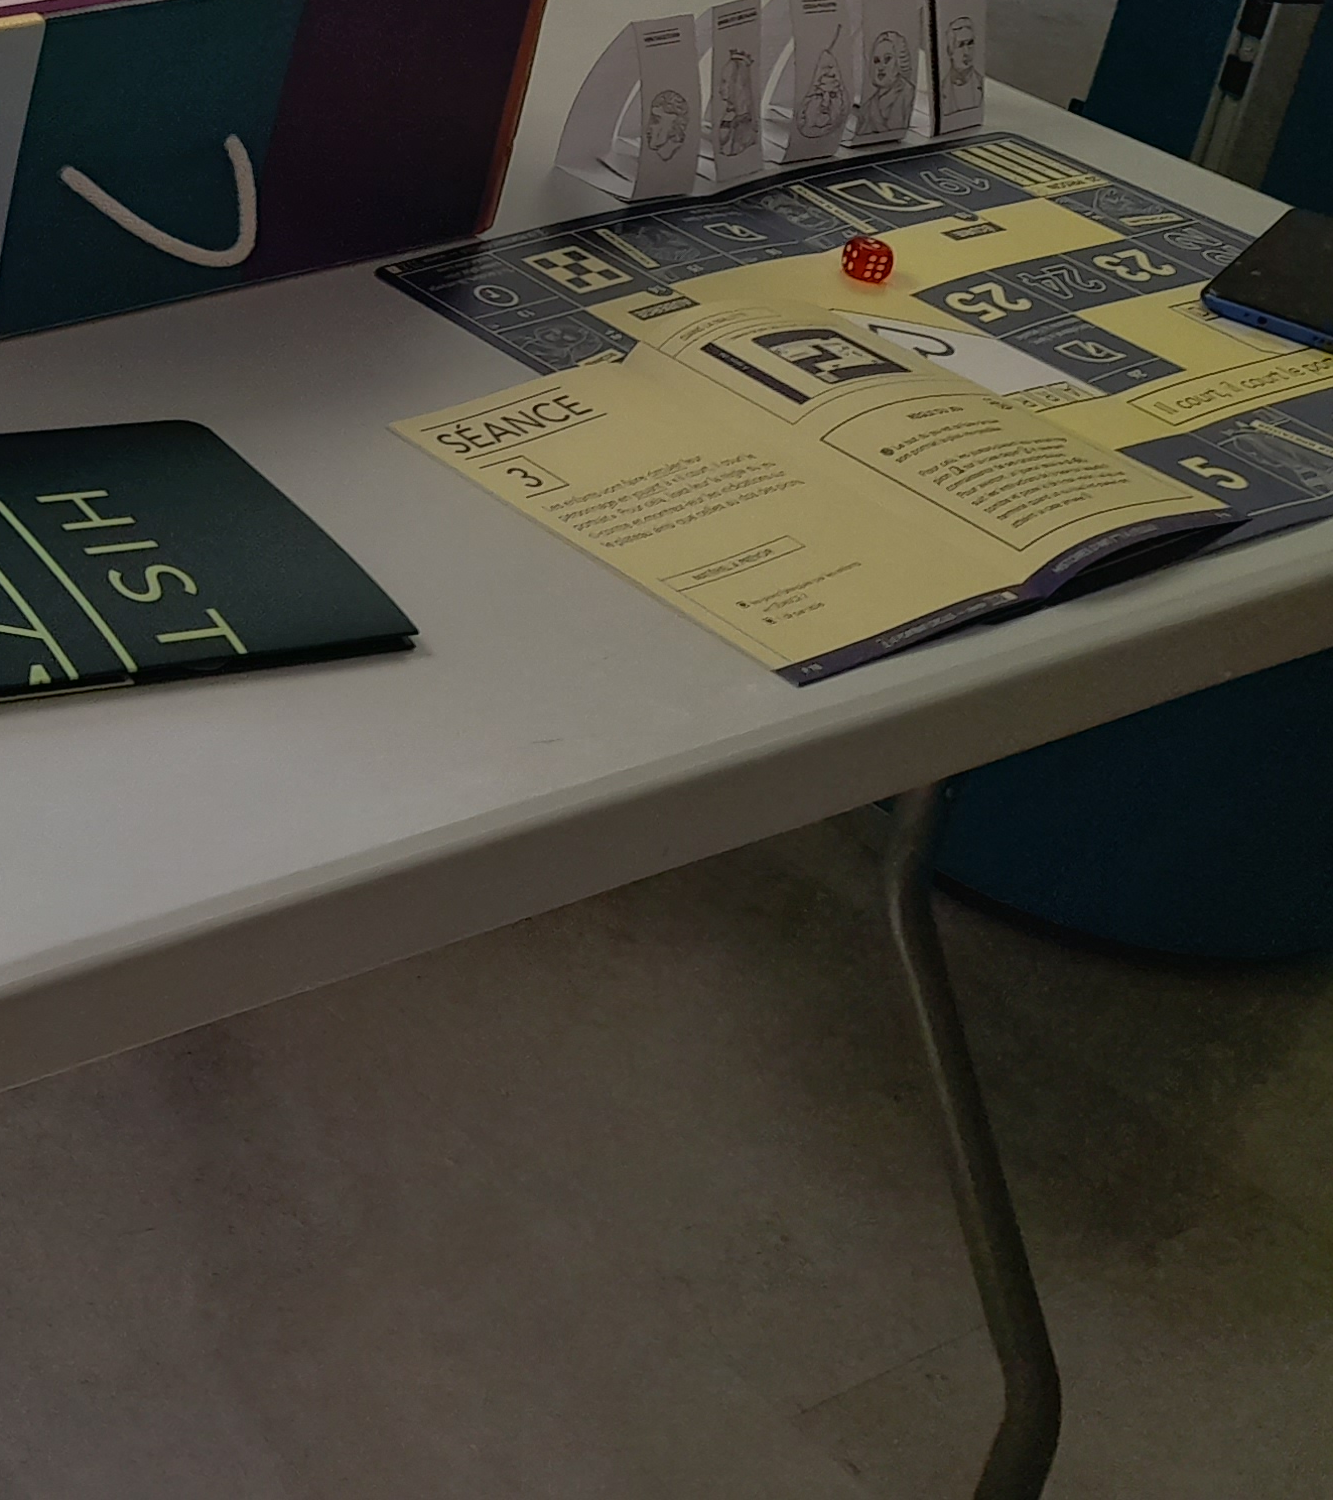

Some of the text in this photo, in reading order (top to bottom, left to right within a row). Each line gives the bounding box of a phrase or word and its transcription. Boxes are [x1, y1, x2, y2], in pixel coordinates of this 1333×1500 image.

[920, 167, 993, 197] 19
[1016, 263, 1107, 300] 24
[1092, 247, 1178, 283] 23
[943, 281, 1033, 323] 25
[1240, 370, 1280, 389] court
[1276, 366, 1305, 379] le
[436, 395, 595, 455] SÉANCE
[505, 466, 544, 490] 3
[1177, 456, 1251, 490] 5
[35, 489, 248, 655] HIST
